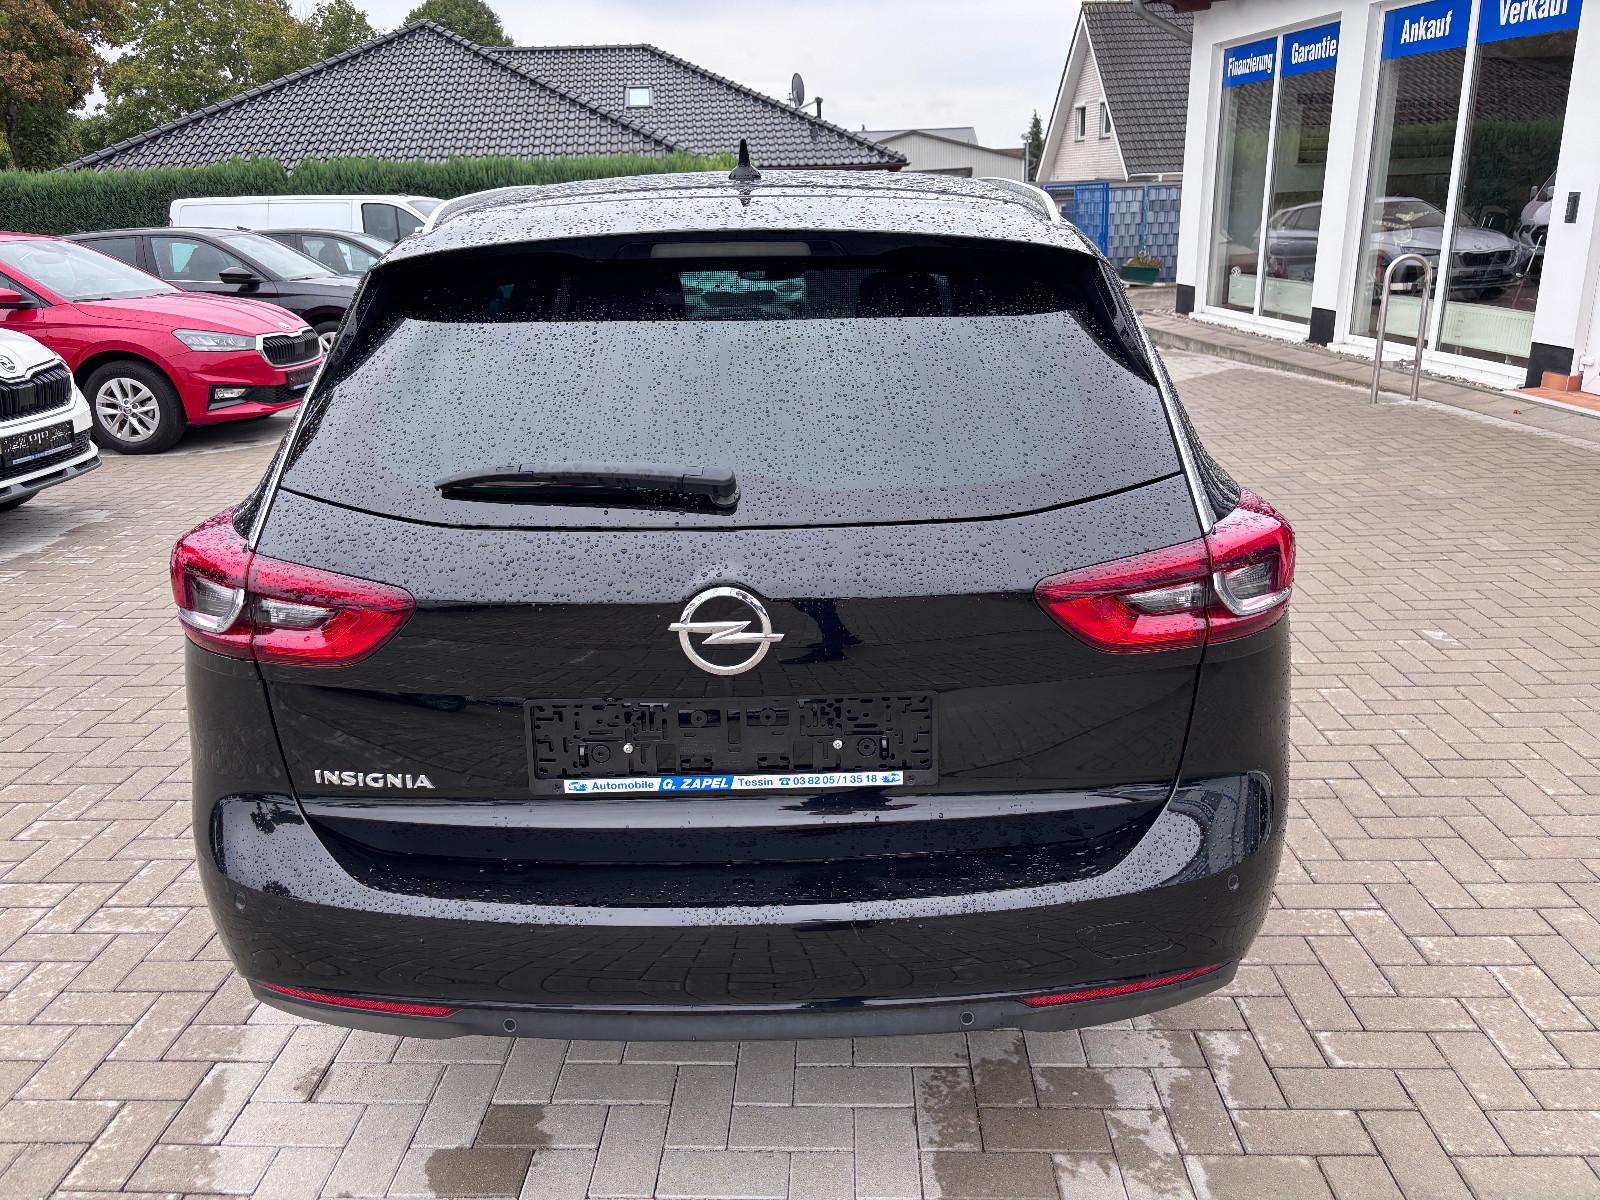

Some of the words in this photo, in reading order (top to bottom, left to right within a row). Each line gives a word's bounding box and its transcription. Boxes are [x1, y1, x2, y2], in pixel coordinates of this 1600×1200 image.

[1400, 9, 1453, 45] Ankauf
[1291, 35, 1337, 65] Garantie
[1227, 52, 1274, 77] Finanzierung
[313, 769, 436, 789] INSIGNIA
[591, 780, 654, 791] Automobile
[662, 778, 676, 790] G.
[680, 777, 730, 789] ZAPEL
[737, 777, 774, 787] Tessin
